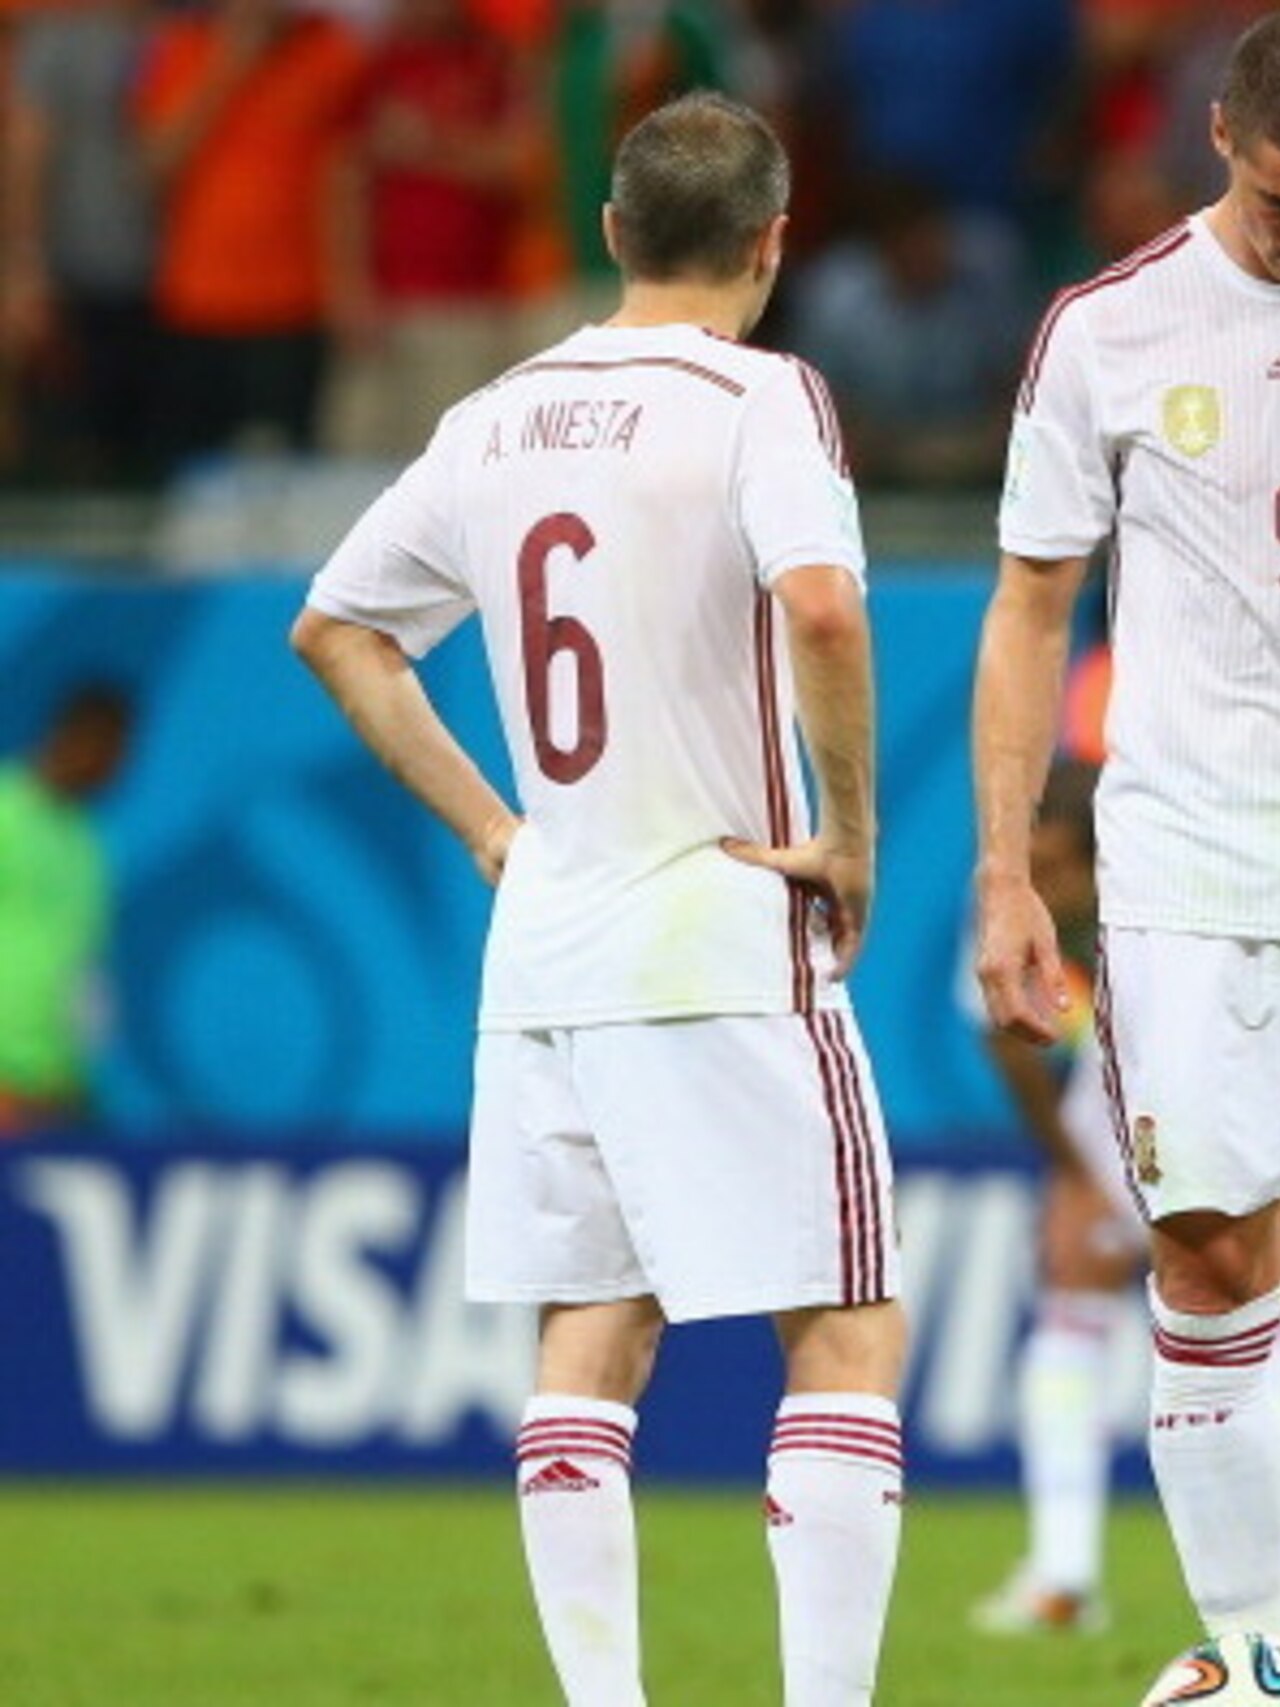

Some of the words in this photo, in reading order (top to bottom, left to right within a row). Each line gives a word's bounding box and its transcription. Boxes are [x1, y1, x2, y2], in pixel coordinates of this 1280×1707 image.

[482, 420, 509, 466] A.
[521, 400, 643, 453] INIESTA
[517, 511, 608, 785] 6
[22, 1157, 542, 1448] VISA
